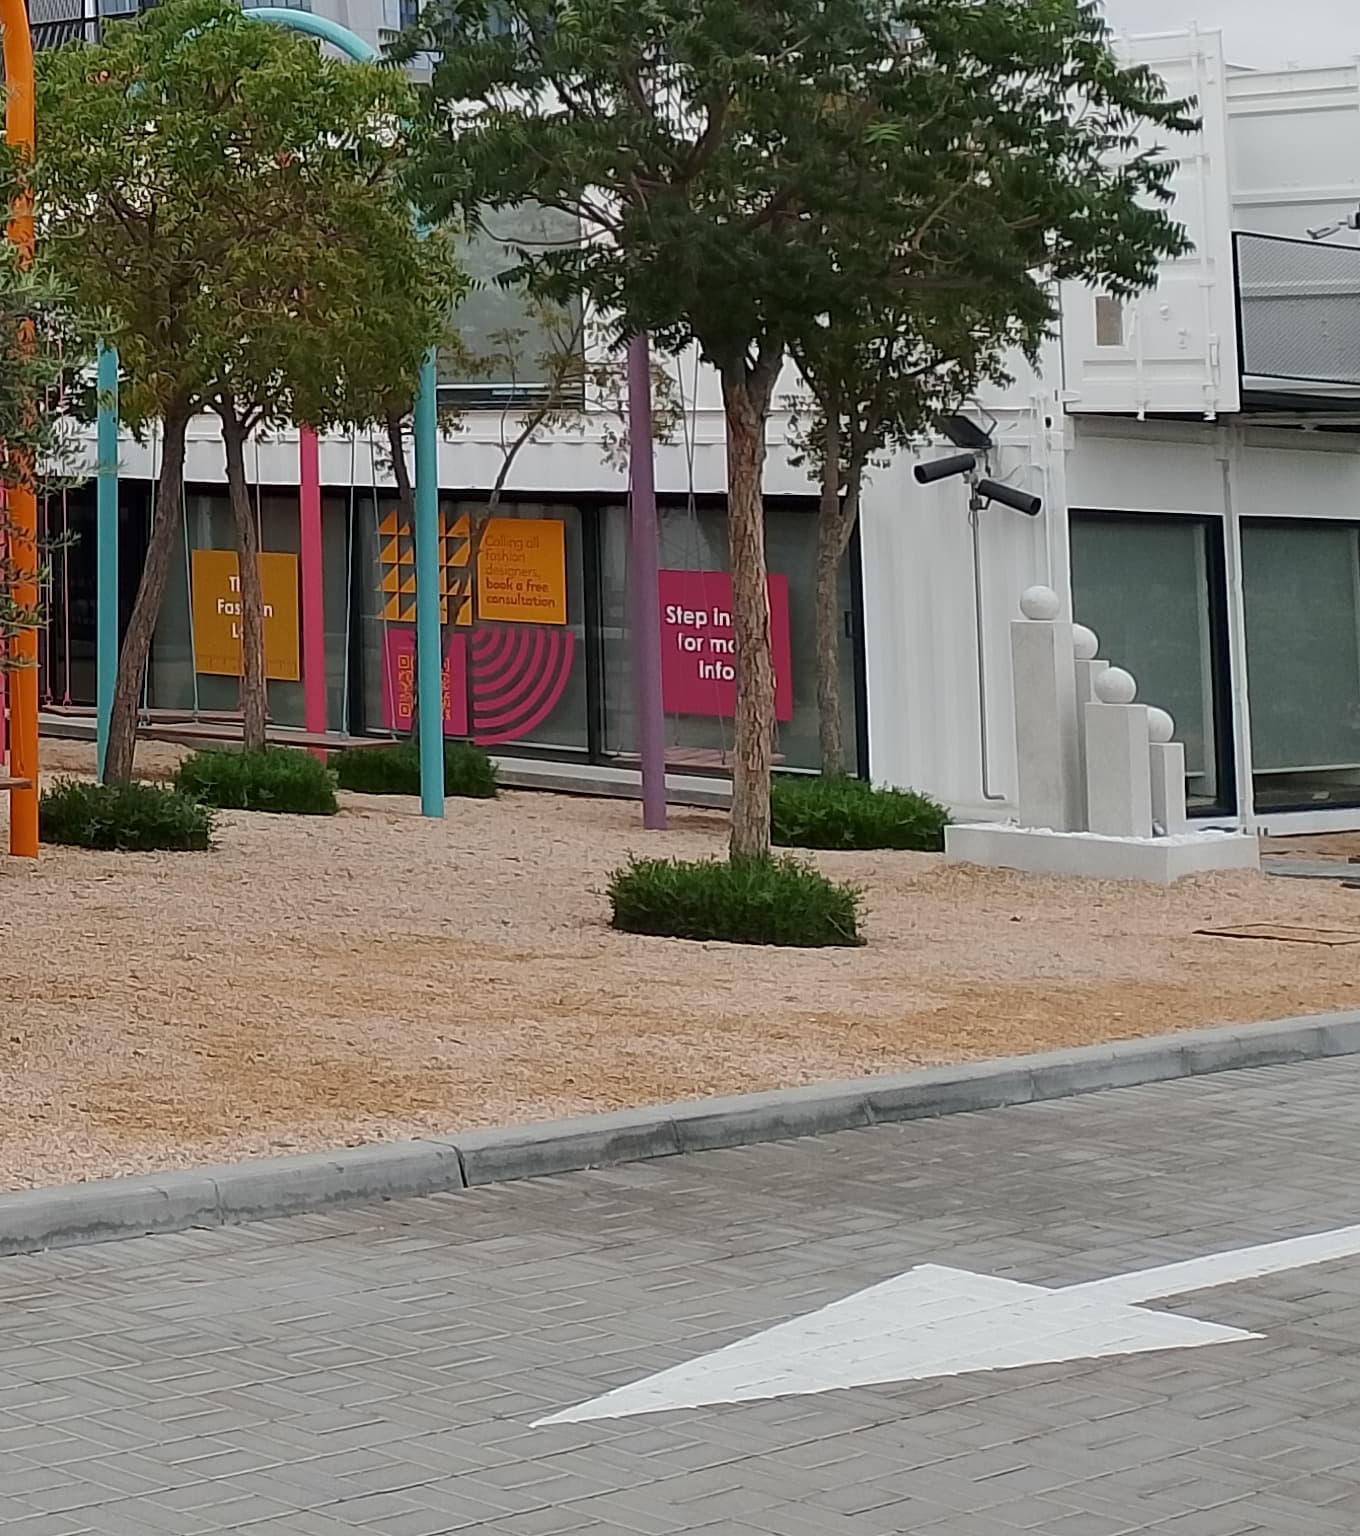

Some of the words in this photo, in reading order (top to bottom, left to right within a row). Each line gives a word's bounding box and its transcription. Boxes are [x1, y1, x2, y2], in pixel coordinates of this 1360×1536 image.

[526, 535, 540, 549] all
[486, 577, 513, 592] book
[516, 582, 523, 591] a
[526, 579, 549, 593] free
[486, 593, 556, 608] consultation
[666, 605, 708, 629] Step
[677, 632, 705, 652] for
